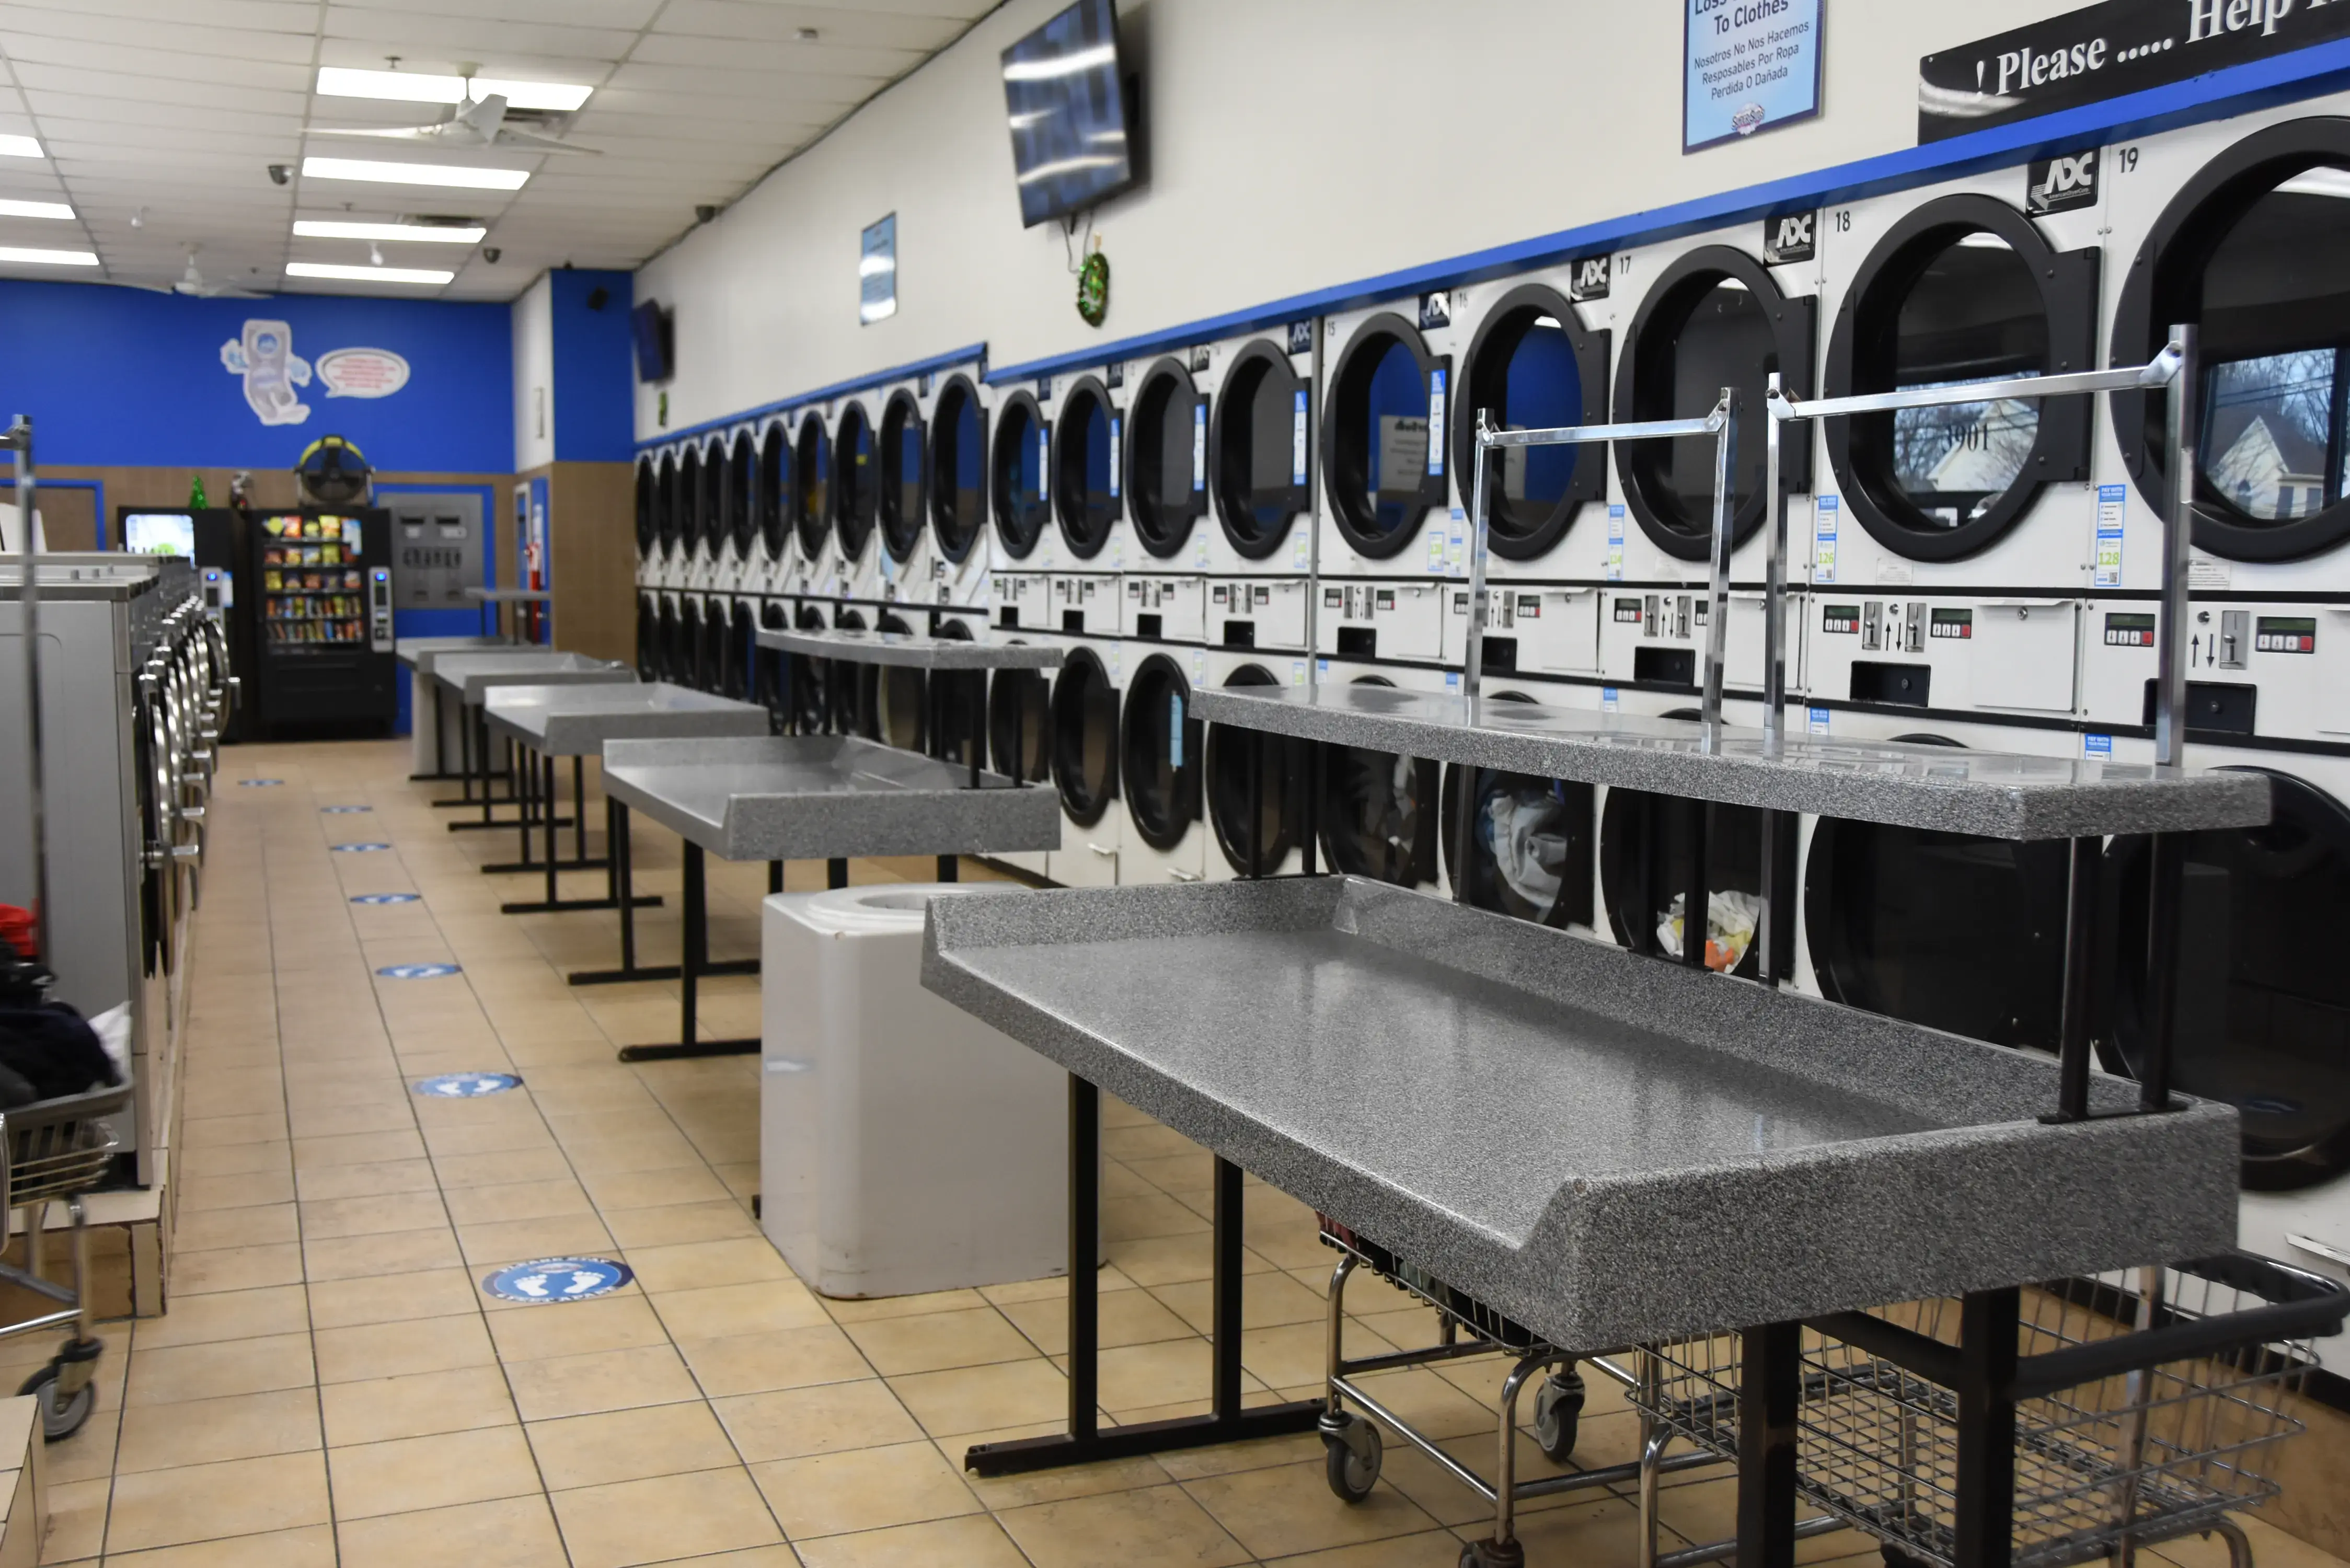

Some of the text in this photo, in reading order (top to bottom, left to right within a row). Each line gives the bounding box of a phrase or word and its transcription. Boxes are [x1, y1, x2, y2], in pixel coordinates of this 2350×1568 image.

[1714, 0, 1789, 35] To Clothes
[1694, 21, 1809, 70] Nosotros No Nos Hacemos
[1995, 38, 2107, 96] Please
[2185, 0, 2291, 43] Help
[1702, 44, 1799, 85] Resposables Por Ropa
[1711, 65, 1788, 100] Perdida O Dañada
[2043, 151, 2093, 195] ADC
[2118, 146, 2139, 174] 19
[1776, 214, 1812, 248] ADC
[1836, 210, 1850, 232] 18
[1580, 257, 1607, 287] ADC
[1620, 255, 1631, 275] 17
[1818, 552, 1834, 564] 126
[2098, 552, 2120, 565] 128
